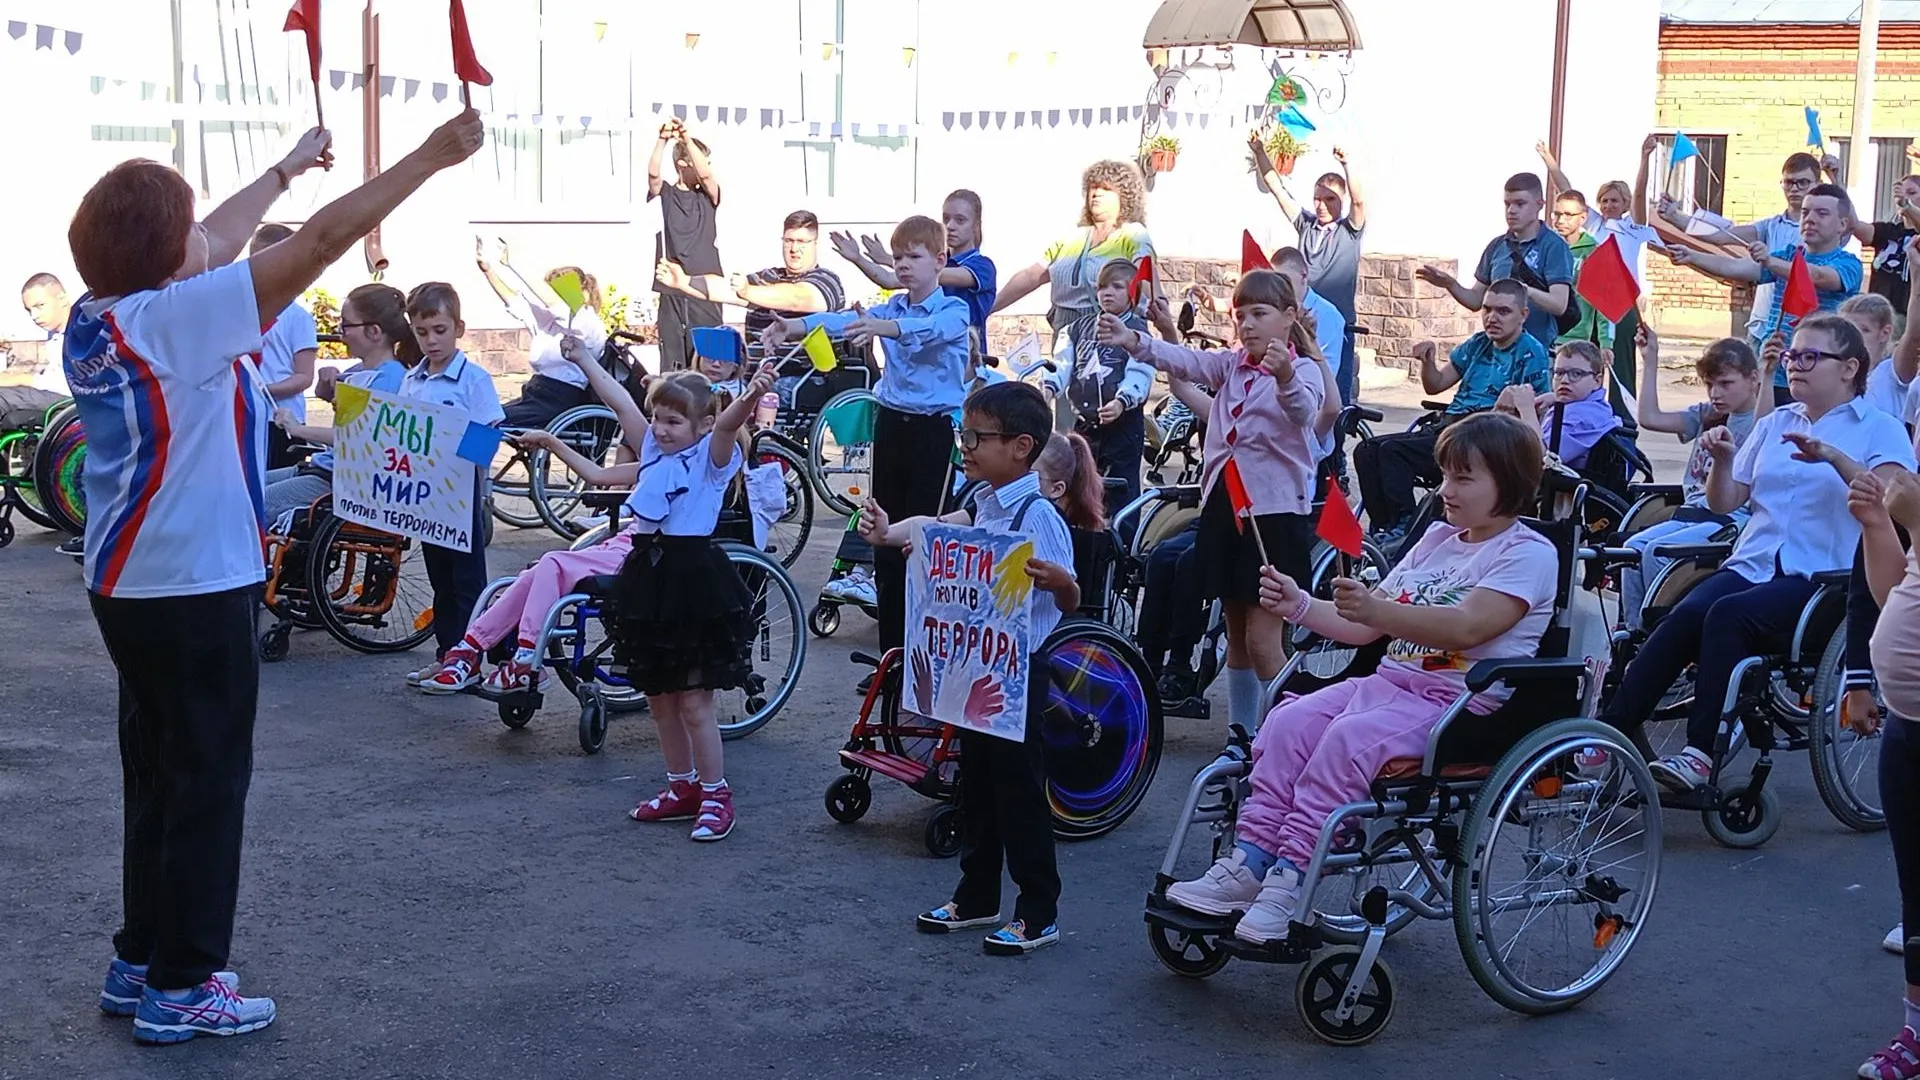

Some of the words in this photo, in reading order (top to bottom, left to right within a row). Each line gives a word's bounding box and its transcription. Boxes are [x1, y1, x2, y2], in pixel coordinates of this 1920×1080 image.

[373, 402, 433, 456] МЫ
[383, 447, 412, 478] ЗА
[372, 473, 431, 506] МИР
[340, 498, 377, 520] ПРОТИВ
[383, 509, 469, 548] ТЕРРОРИЗМА
[929, 538, 994, 585] ДЕТИ
[934, 585, 979, 611] ПРОТИВ
[923, 616, 1018, 679] ТЕРРОРА
